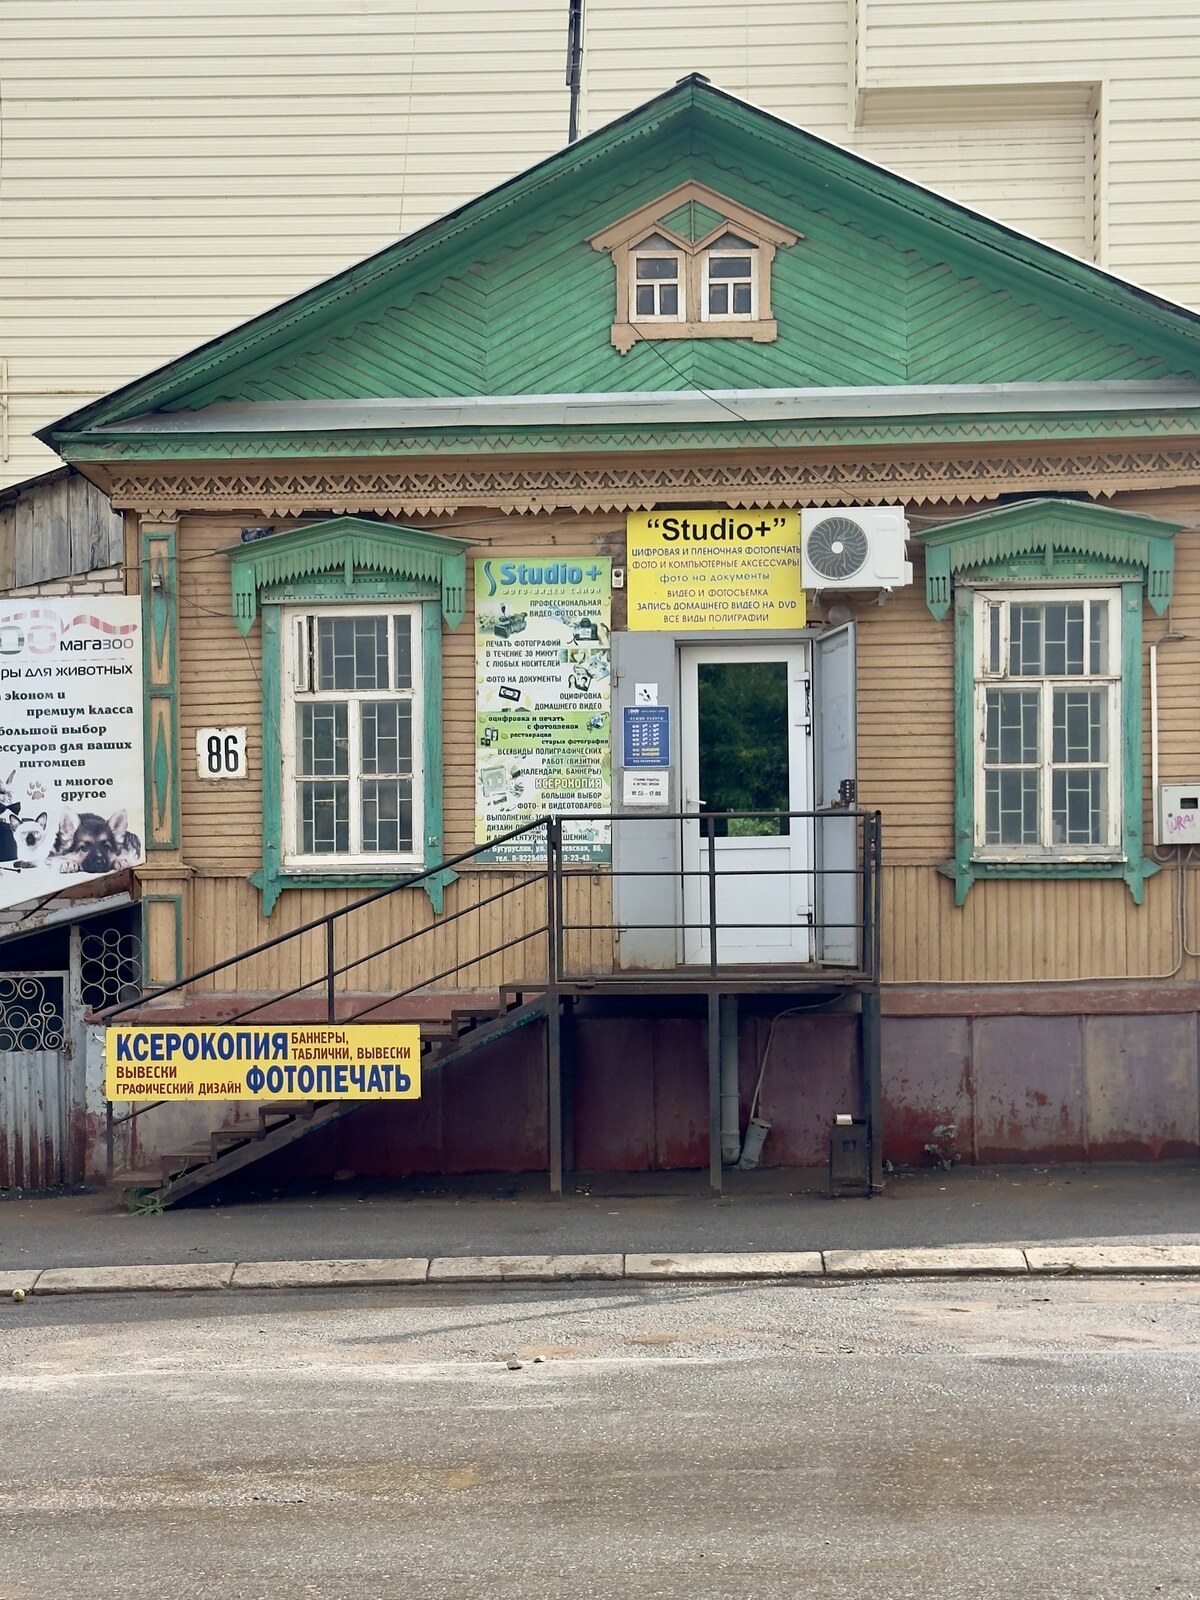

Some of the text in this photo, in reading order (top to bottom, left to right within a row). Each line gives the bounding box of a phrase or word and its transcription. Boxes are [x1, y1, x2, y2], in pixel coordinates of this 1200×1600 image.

[669, 560, 738, 568] КОМПЬЮТЕРНЫЕ
[660, 575, 688, 583] фото
[711, 573, 769, 582] документы
[674, 602, 728, 610] ДОМАШНЕГО
[25, 668, 52, 677] для
[56, 665, 133, 676] животных
[5, 691, 53, 700] эконом
[27, 705, 133, 718] премиум класса
[488, 716, 530, 724] оцифровка
[62, 724, 106, 736] выбор
[60, 743, 83, 753] для
[207, 735, 238, 773] 86
[20, 760, 85, 768] питомцев
[534, 778, 602, 789] КСЕРОКОПИЯ
[61, 791, 106, 801] другое
[292, 1032, 348, 1045] БАННЕРЫ,
[116, 1032, 287, 1061] КСЕРОКОПИЯ
[292, 1047, 410, 1061] ТАБЛИЧКИ, ВЫВЕСКИ
[116, 1066, 177, 1078] ВЫВЕСКИ
[246, 1065, 411, 1094] ФОТОПЕЧАТЬ
[116, 1081, 241, 1095] ГРАФИЧЕСКИЙ ДИЗАЙН
